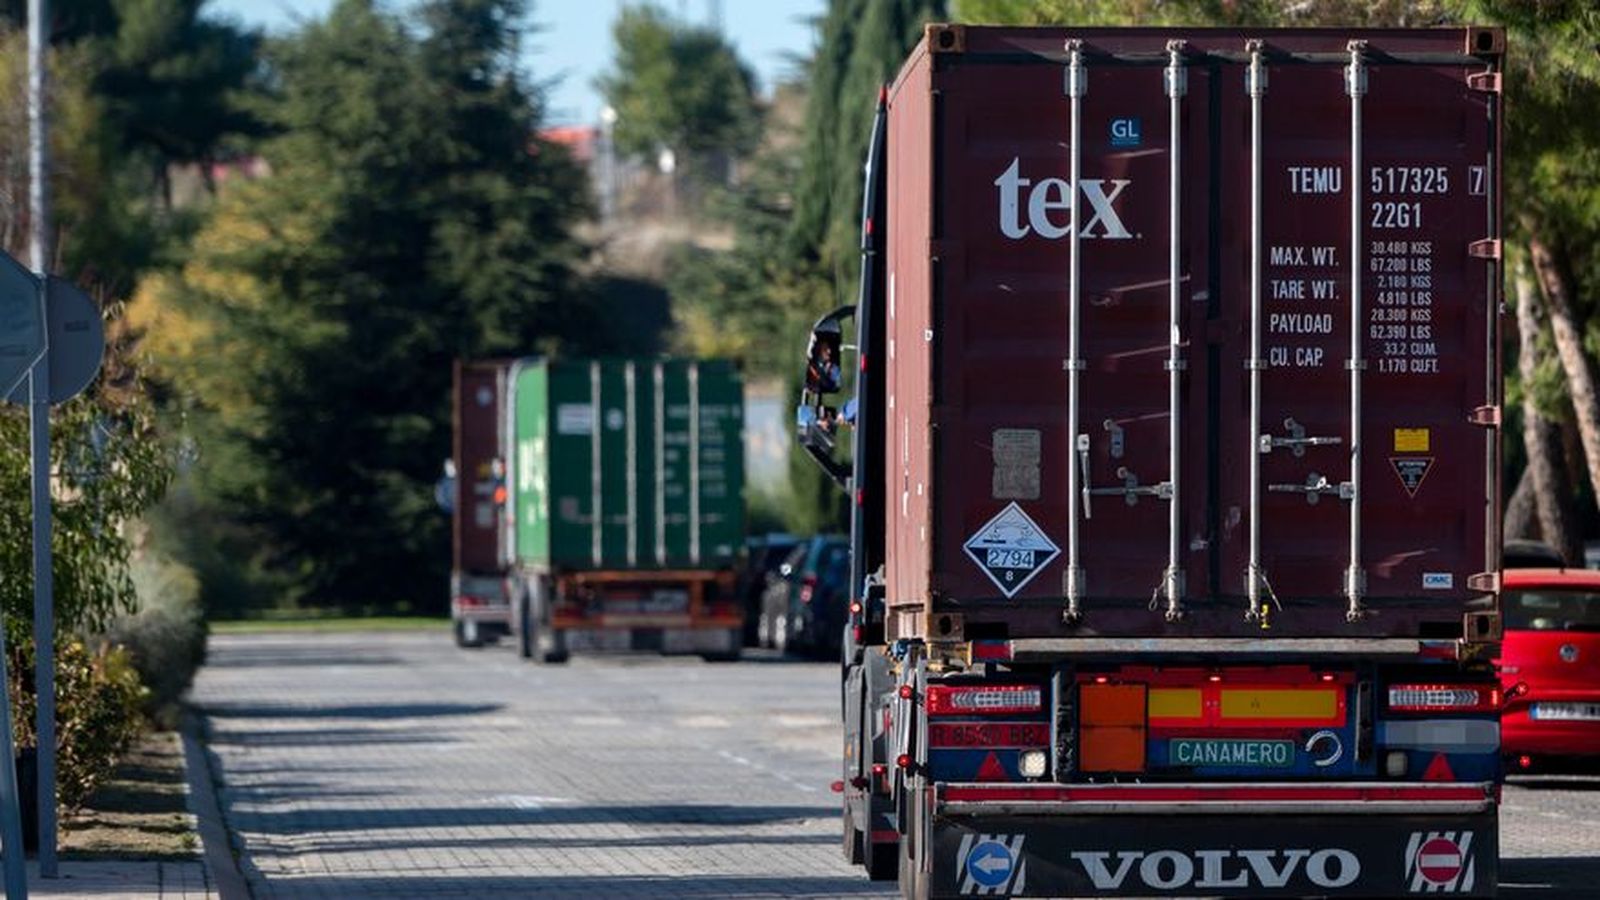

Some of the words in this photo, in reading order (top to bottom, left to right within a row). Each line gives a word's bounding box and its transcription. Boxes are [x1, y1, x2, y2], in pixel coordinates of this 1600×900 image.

[1112, 119, 1139, 137] GL
[1288, 166, 1342, 194] TEMU
[1371, 166, 1448, 194] 517325
[1472, 167, 1483, 194] 7
[1371, 202, 1422, 228] 22G1
[1270, 246, 1308, 267] MAX.
[1312, 246, 1339, 267] WT.
[1371, 241, 1407, 255] 30.480
[1410, 241, 1432, 255] KGS
[1410, 257, 1432, 272] LBS
[1271, 279, 1305, 300] TARE
[1312, 279, 1339, 300] WT.
[1378, 275, 1407, 288] 2.180
[1410, 275, 1432, 288] KGS
[1377, 291, 1407, 306] 4.810
[1410, 291, 1432, 306] LBS
[1270, 313, 1332, 334] PAYLOAD
[1370, 308, 1407, 322] 28.300
[1410, 308, 1431, 322] KGS
[1370, 325, 1407, 340] 62.390
[1410, 325, 1431, 340] LBS
[1270, 347, 1291, 367] CU.
[1296, 347, 1323, 367] CAP.
[1383, 342, 1407, 356] 33.2
[1378, 358, 1407, 373] 1.170
[988, 551, 1033, 567] 2794
[1005, 570, 1014, 581] 8
[1178, 741, 1287, 763] CAÑAMERO
[1071, 849, 1360, 890] VOLVO
